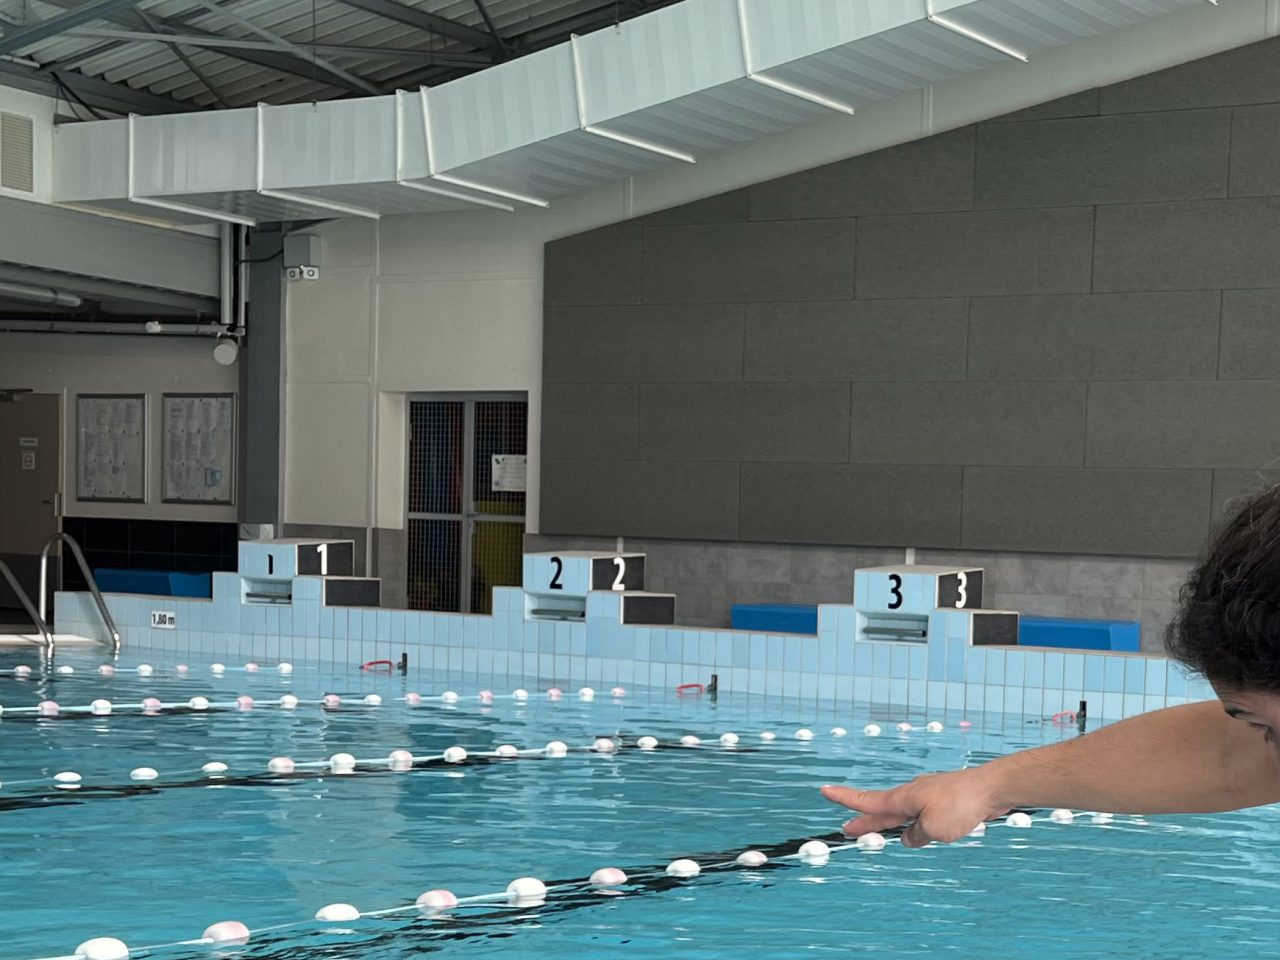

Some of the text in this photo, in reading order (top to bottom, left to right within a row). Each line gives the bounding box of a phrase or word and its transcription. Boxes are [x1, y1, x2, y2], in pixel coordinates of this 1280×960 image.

[267, 553, 274, 575] 1
[316, 543, 328, 576] 1
[549, 556, 563, 590] 2
[611, 556, 626, 591] 2
[887, 573, 903, 609] 3
[954, 571, 967, 609] 3
